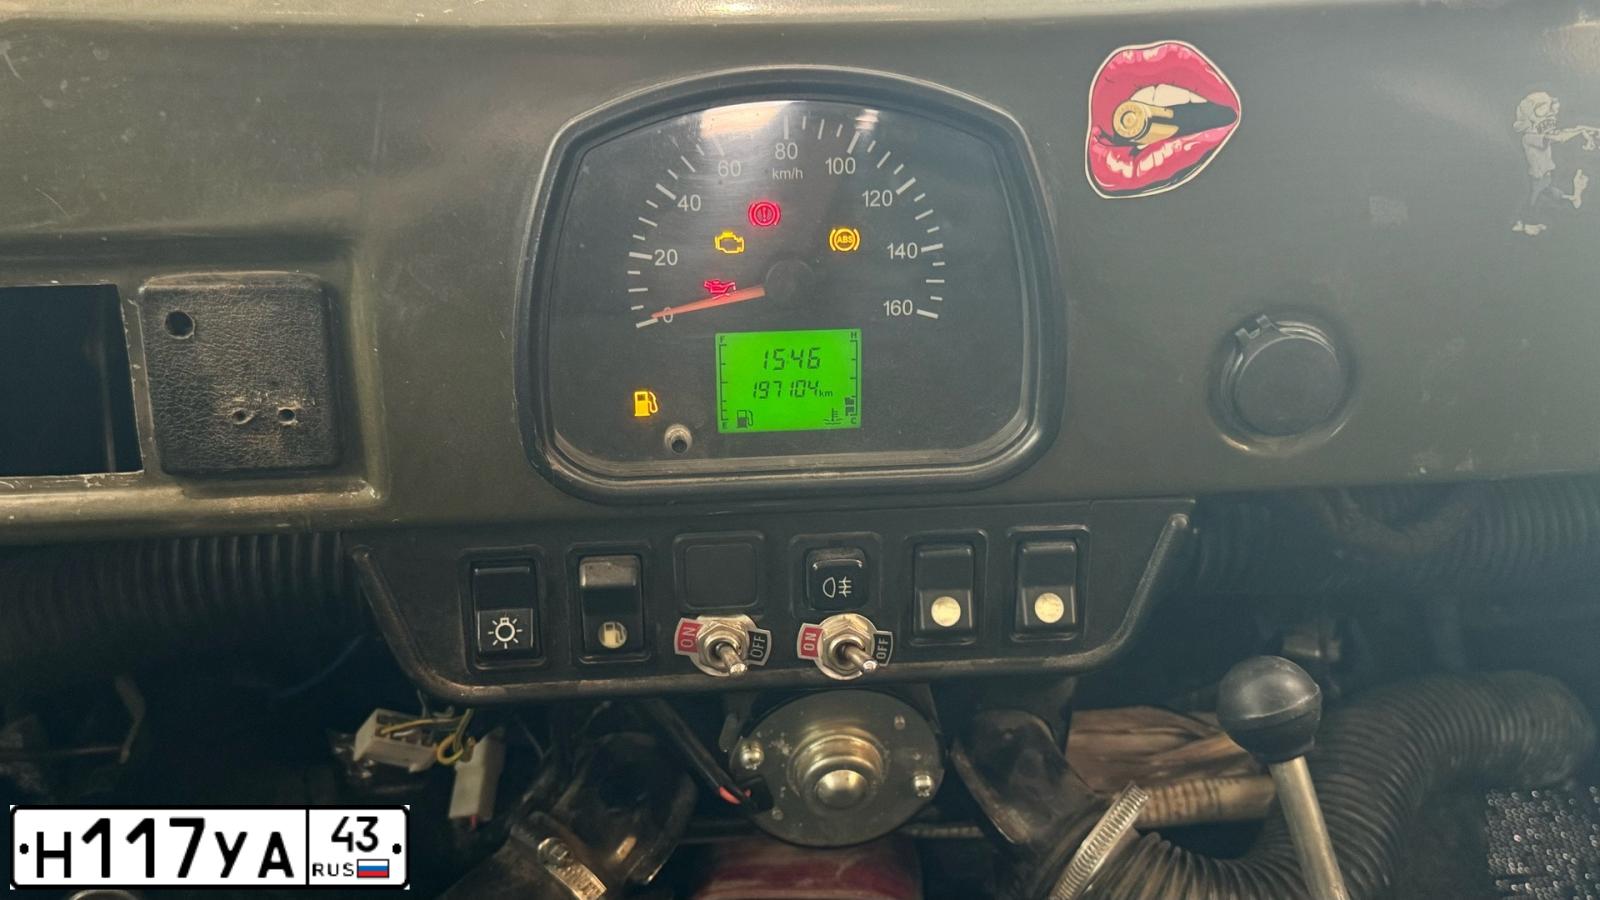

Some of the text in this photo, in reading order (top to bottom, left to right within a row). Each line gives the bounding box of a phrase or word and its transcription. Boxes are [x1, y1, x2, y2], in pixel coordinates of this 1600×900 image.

[774, 143, 798, 160] 80
[718, 161, 741, 177] 60
[772, 167, 804, 181] km/h
[825, 157, 856, 175] 100
[677, 194, 702, 212] 40
[862, 190, 893, 207] 120
[836, 234, 854, 244] ABS
[655, 249, 678, 266] 20
[887, 243, 918, 260] 140
[663, 307, 674, 324] 0
[883, 300, 913, 316] 160
[764, 347, 821, 370] 1546
[753, 379, 819, 399] 197104
[680, 626, 695, 648] ON
[751, 631, 767, 658] OFF
[803, 631, 817, 652] ON
[876, 637, 889, 660] OFF
